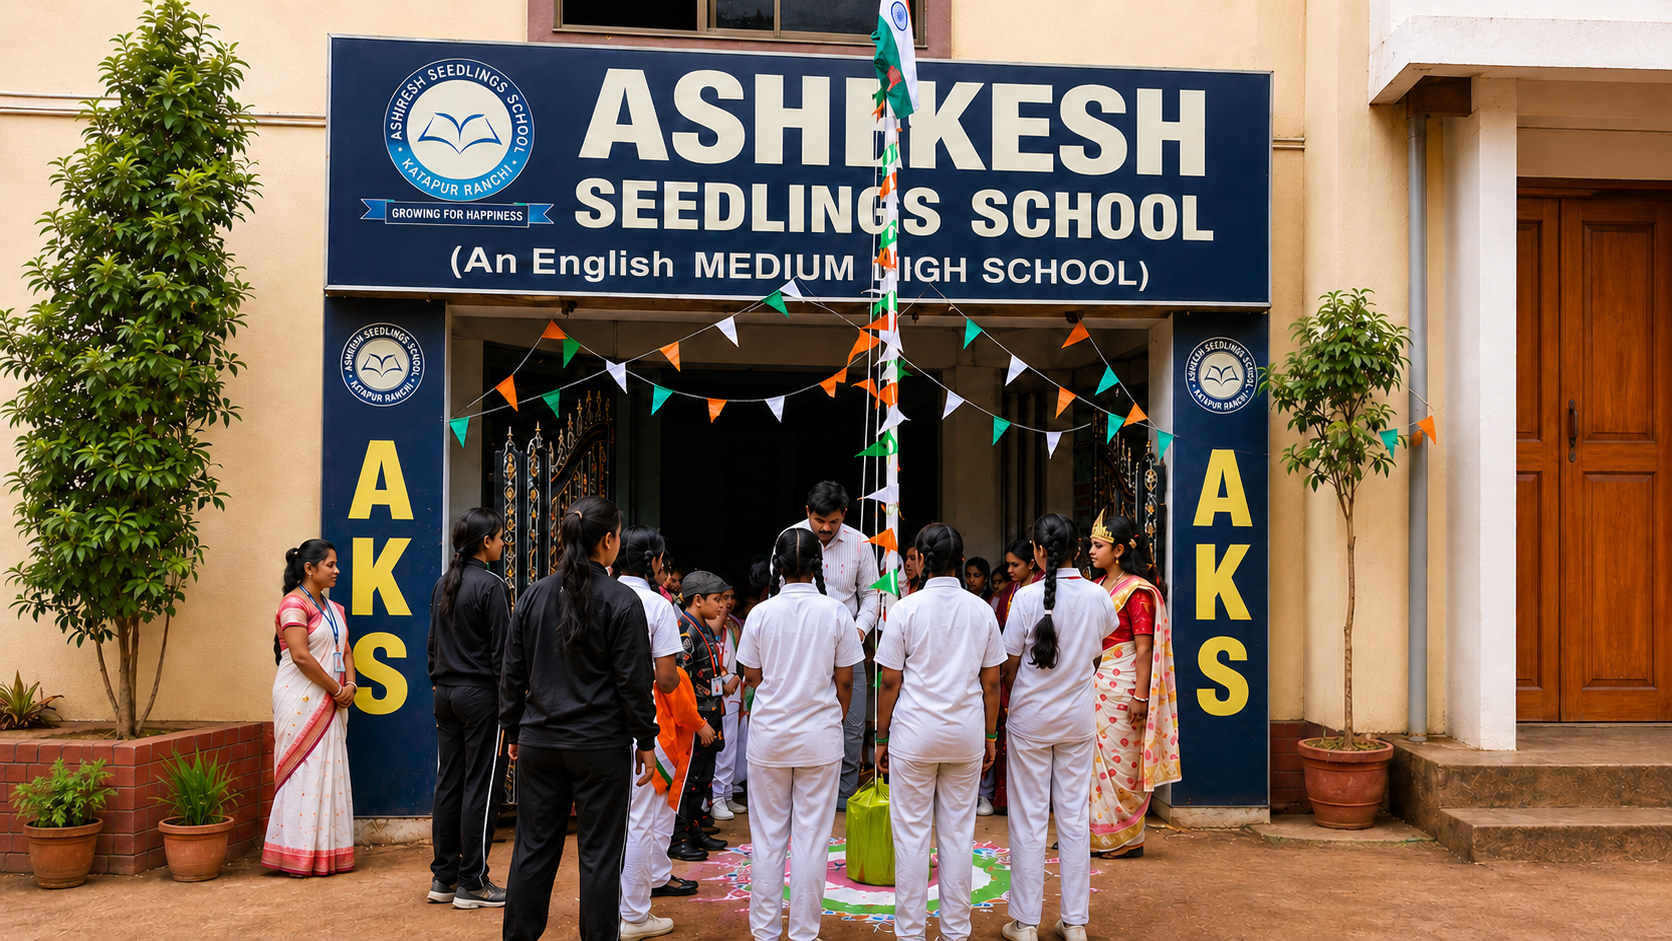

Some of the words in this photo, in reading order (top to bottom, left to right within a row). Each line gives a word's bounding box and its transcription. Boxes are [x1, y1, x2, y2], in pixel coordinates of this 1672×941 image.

[390, 76, 427, 140] ASHIRESH
[427, 64, 508, 93] SEEDLINGS
[506, 94, 529, 153] SCHOOL
[401, 158, 458, 196] KATAPUR
[464, 164, 513, 196] RANCHI
[391, 208, 440, 219] GROWING
[443, 209, 464, 219] FOR
[466, 210, 523, 221] HAPPINESS
[574, 178, 942, 236] SEEDLINGS
[971, 189, 1214, 241] SCHOOL
[450, 246, 517, 279] (An
[532, 248, 674, 283] English
[694, 252, 854, 281] MEDIUM
[982, 258, 1149, 292] SCHOOL)
[363, 327, 410, 344] SEEDLINGS
